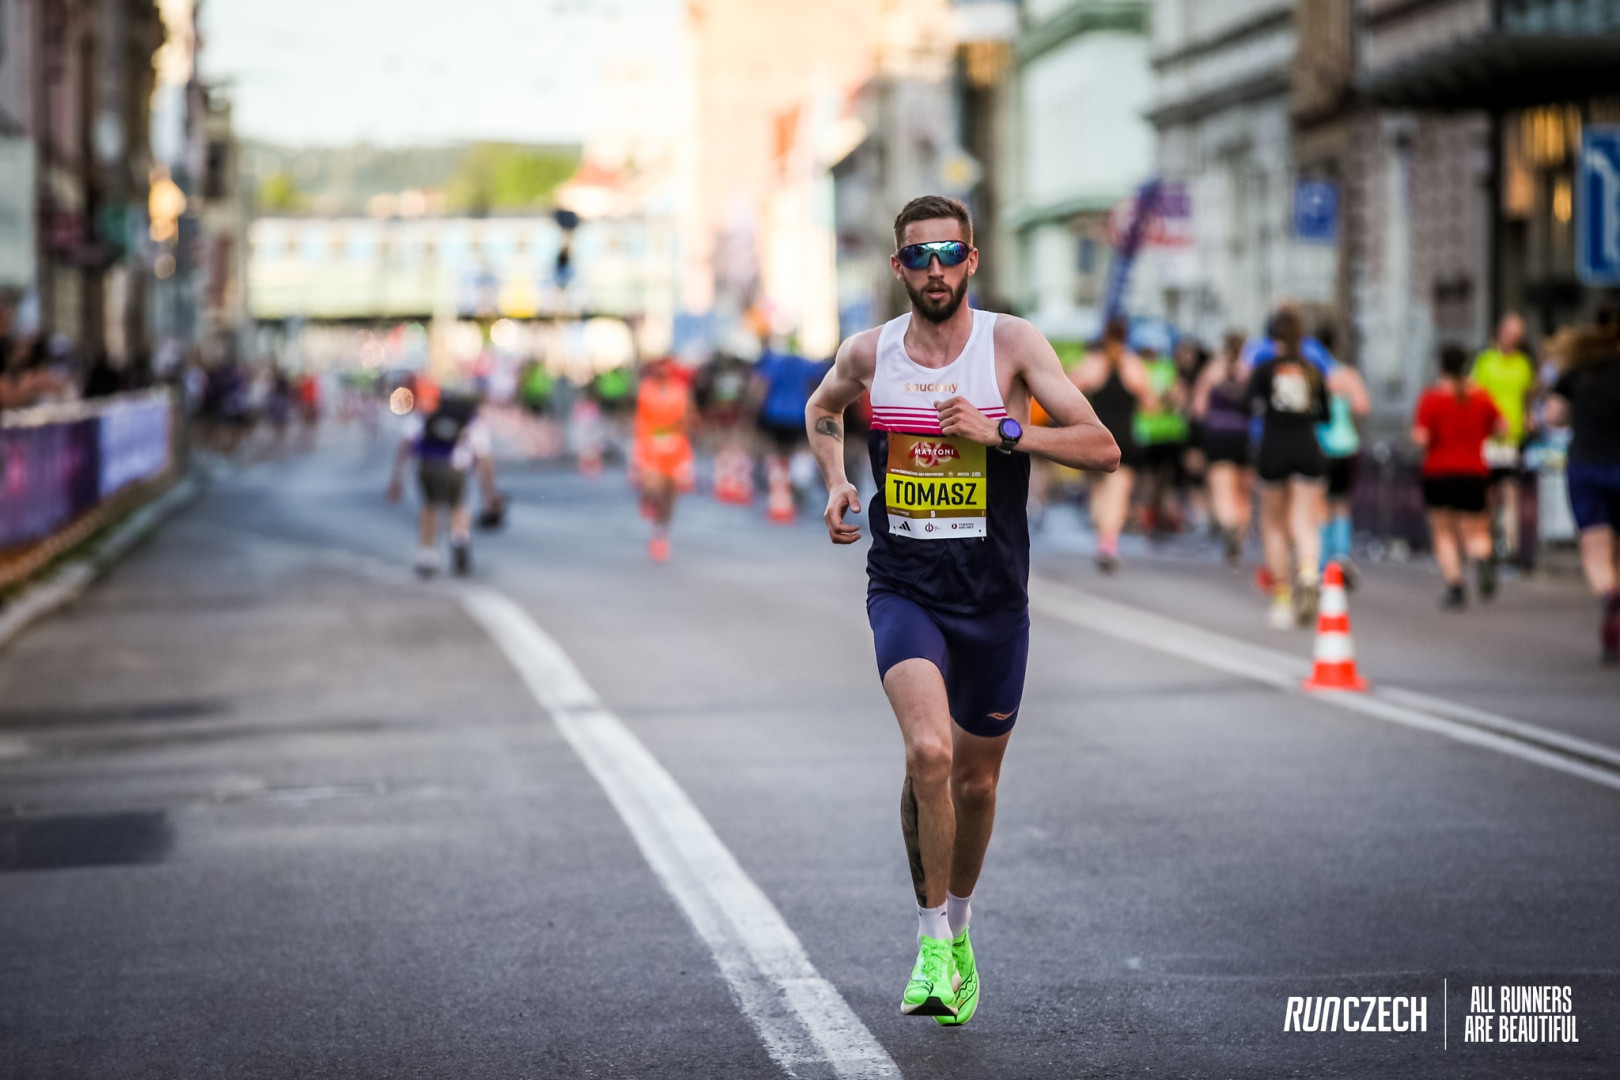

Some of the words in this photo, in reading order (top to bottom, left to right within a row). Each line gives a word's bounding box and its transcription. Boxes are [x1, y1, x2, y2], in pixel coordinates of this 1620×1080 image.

[903, 382, 958, 394] saucony
[914, 448, 954, 456] MATTONI
[893, 479, 977, 506] TOMASZ
